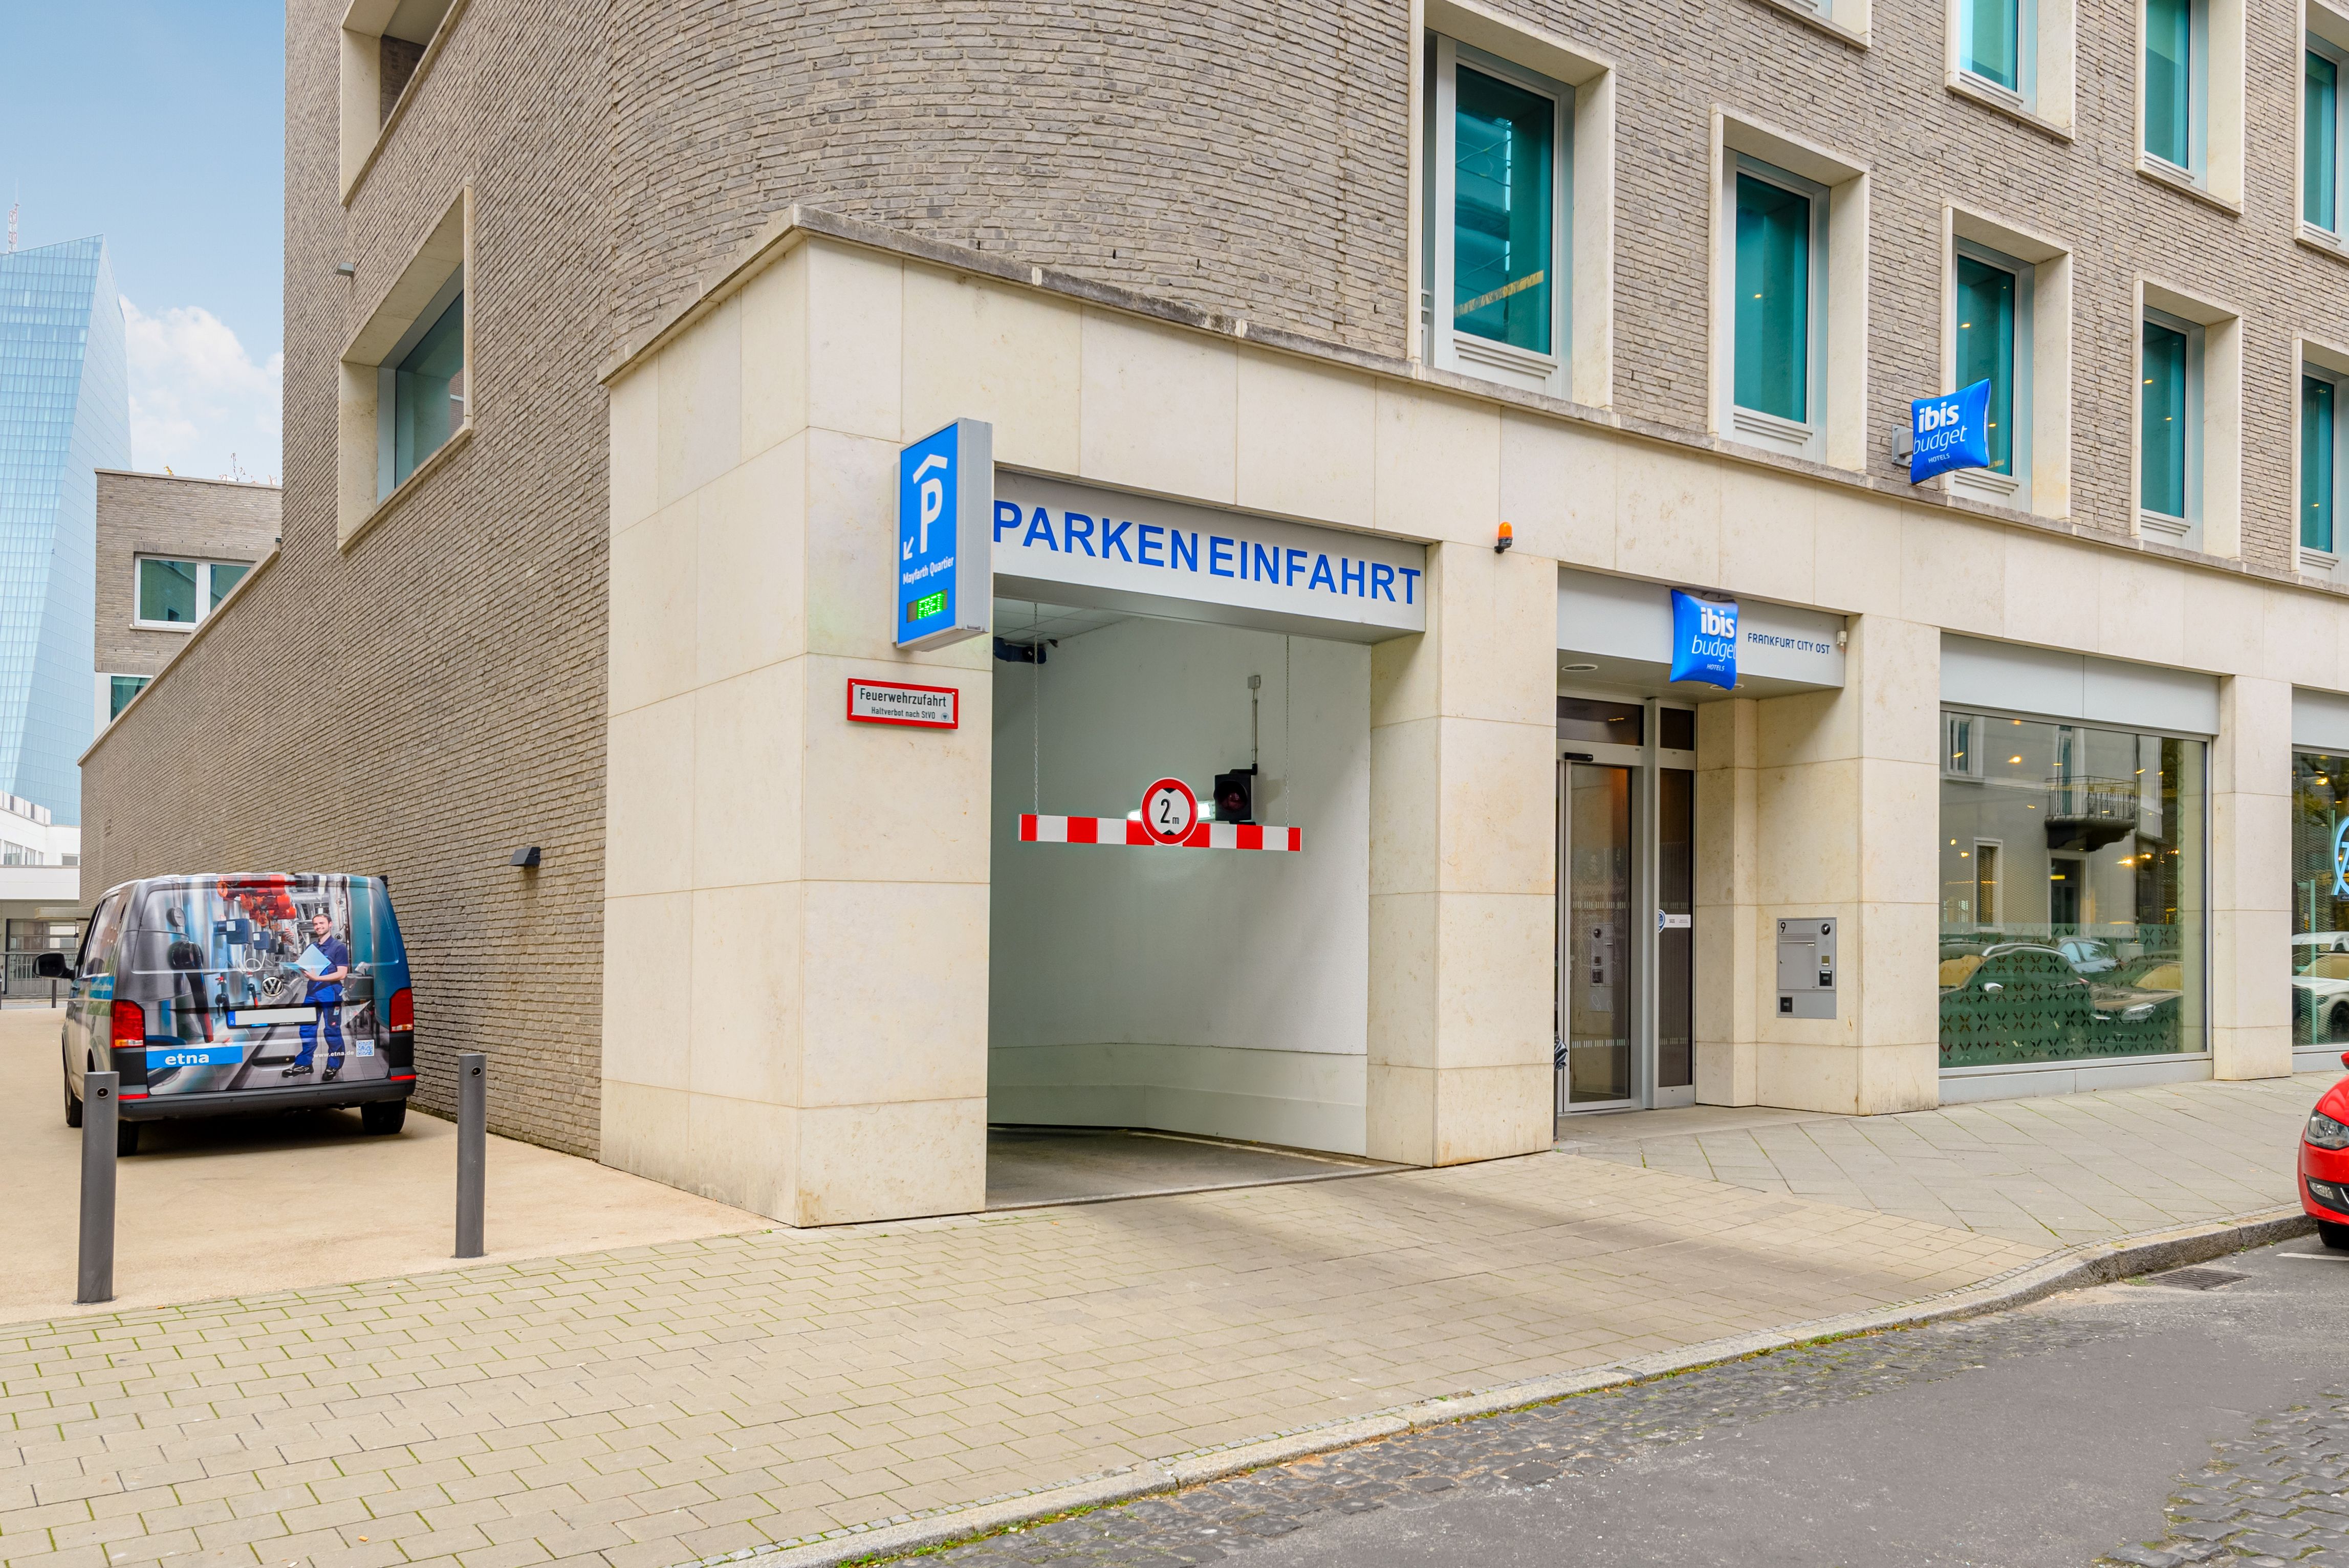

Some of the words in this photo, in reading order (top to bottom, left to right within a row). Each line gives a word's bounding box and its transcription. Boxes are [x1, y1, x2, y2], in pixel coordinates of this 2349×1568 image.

[1919, 402, 1959, 433] ibis
[1913, 425, 1968, 455] budget
[1928, 453, 1950, 463] HOTELS
[919, 478, 943, 554] P
[993, 500, 1198, 572] PARKEN
[1209, 536, 1421, 605] EINFAHRT
[903, 565, 928, 585] Mayfarth
[929, 556, 954, 577] Quartier
[1700, 607, 1735, 639] ibis
[1748, 633, 1795, 648] FRANKFURT
[1797, 640, 1814, 651] CITY
[1815, 643, 1830, 654] OST
[1706, 663, 1725, 671] HOTELS
[860, 688, 946, 707] Feuerwehrzufahrt
[871, 707, 903, 716] Haltverbot
[921, 711, 936, 719] StVO
[1160, 798, 1171, 823] 2
[1780, 922, 1786, 933] 9
[165, 1053, 209, 1065] etna
